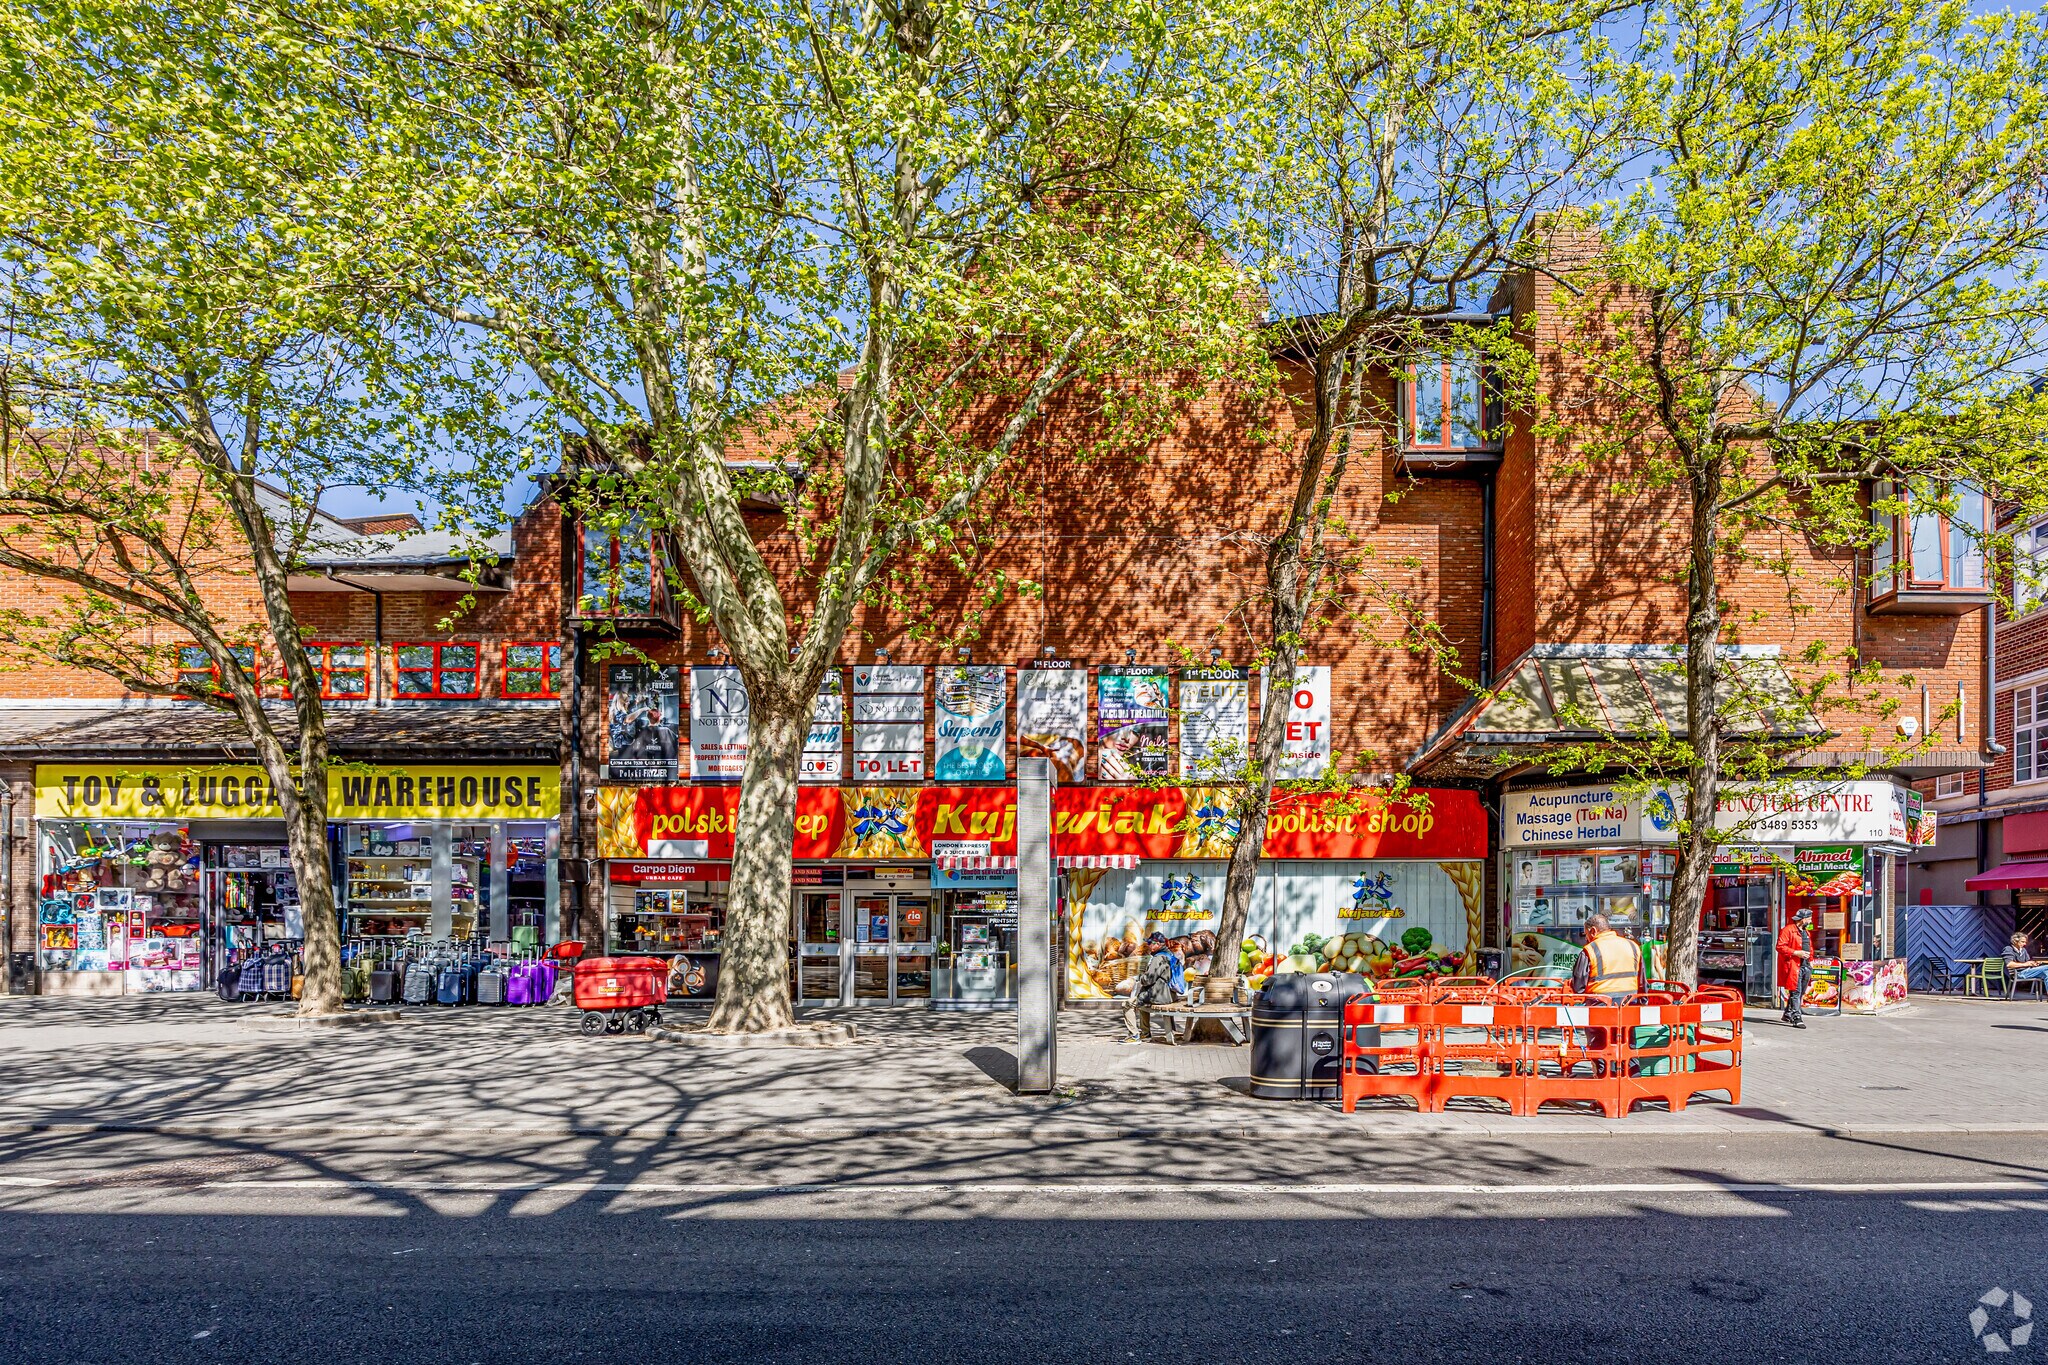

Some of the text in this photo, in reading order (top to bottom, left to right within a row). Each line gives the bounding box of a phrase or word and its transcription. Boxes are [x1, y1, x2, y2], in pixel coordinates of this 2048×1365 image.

[1044, 660, 1071, 668] FLOOR
[1126, 667, 1154, 676] FLOOR
[1186, 669, 1240, 680] 1st FLOOR
[1200, 685, 1246, 697] ELITE
[1294, 689, 1314, 709] O
[1130, 709, 1167, 719] TREADMILL
[807, 726, 840, 743] erB
[938, 719, 1004, 744] SuperB
[1286, 721, 1322, 741] ET
[700, 743, 718, 751] SALES
[725, 743, 747, 751] LETTING
[857, 760, 922, 773] TO LET
[62, 775, 542, 808] TOY & LUGGA WAREHOUSE
[1529, 791, 1614, 808] Acupuncture
[1682, 794, 1874, 813] PUNCTURE CENTRE
[1516, 812, 1572, 826] Massage
[1604, 805, 1628, 822] Na)
[651, 806, 736, 840] polski
[932, 803, 1179, 843] Kujwiak
[1367, 806, 1435, 840] shop
[1760, 820, 1788, 830] 3489
[1791, 820, 1818, 830] 5353
[1522, 824, 1621, 842] Chinese Herbal
[1869, 829, 1883, 837] 110
[1713, 853, 1780, 863] alal Btche
[1794, 848, 1853, 863] Ahmed
[632, 864, 695, 874] Carpe Diem
[1798, 863, 1849, 871] Halal Meat
[907, 911, 921, 920] ria
[1146, 908, 1214, 922] Kujawiak
[1338, 907, 1406, 921] Kujawiak
[1552, 953, 1579, 963] CHINES
